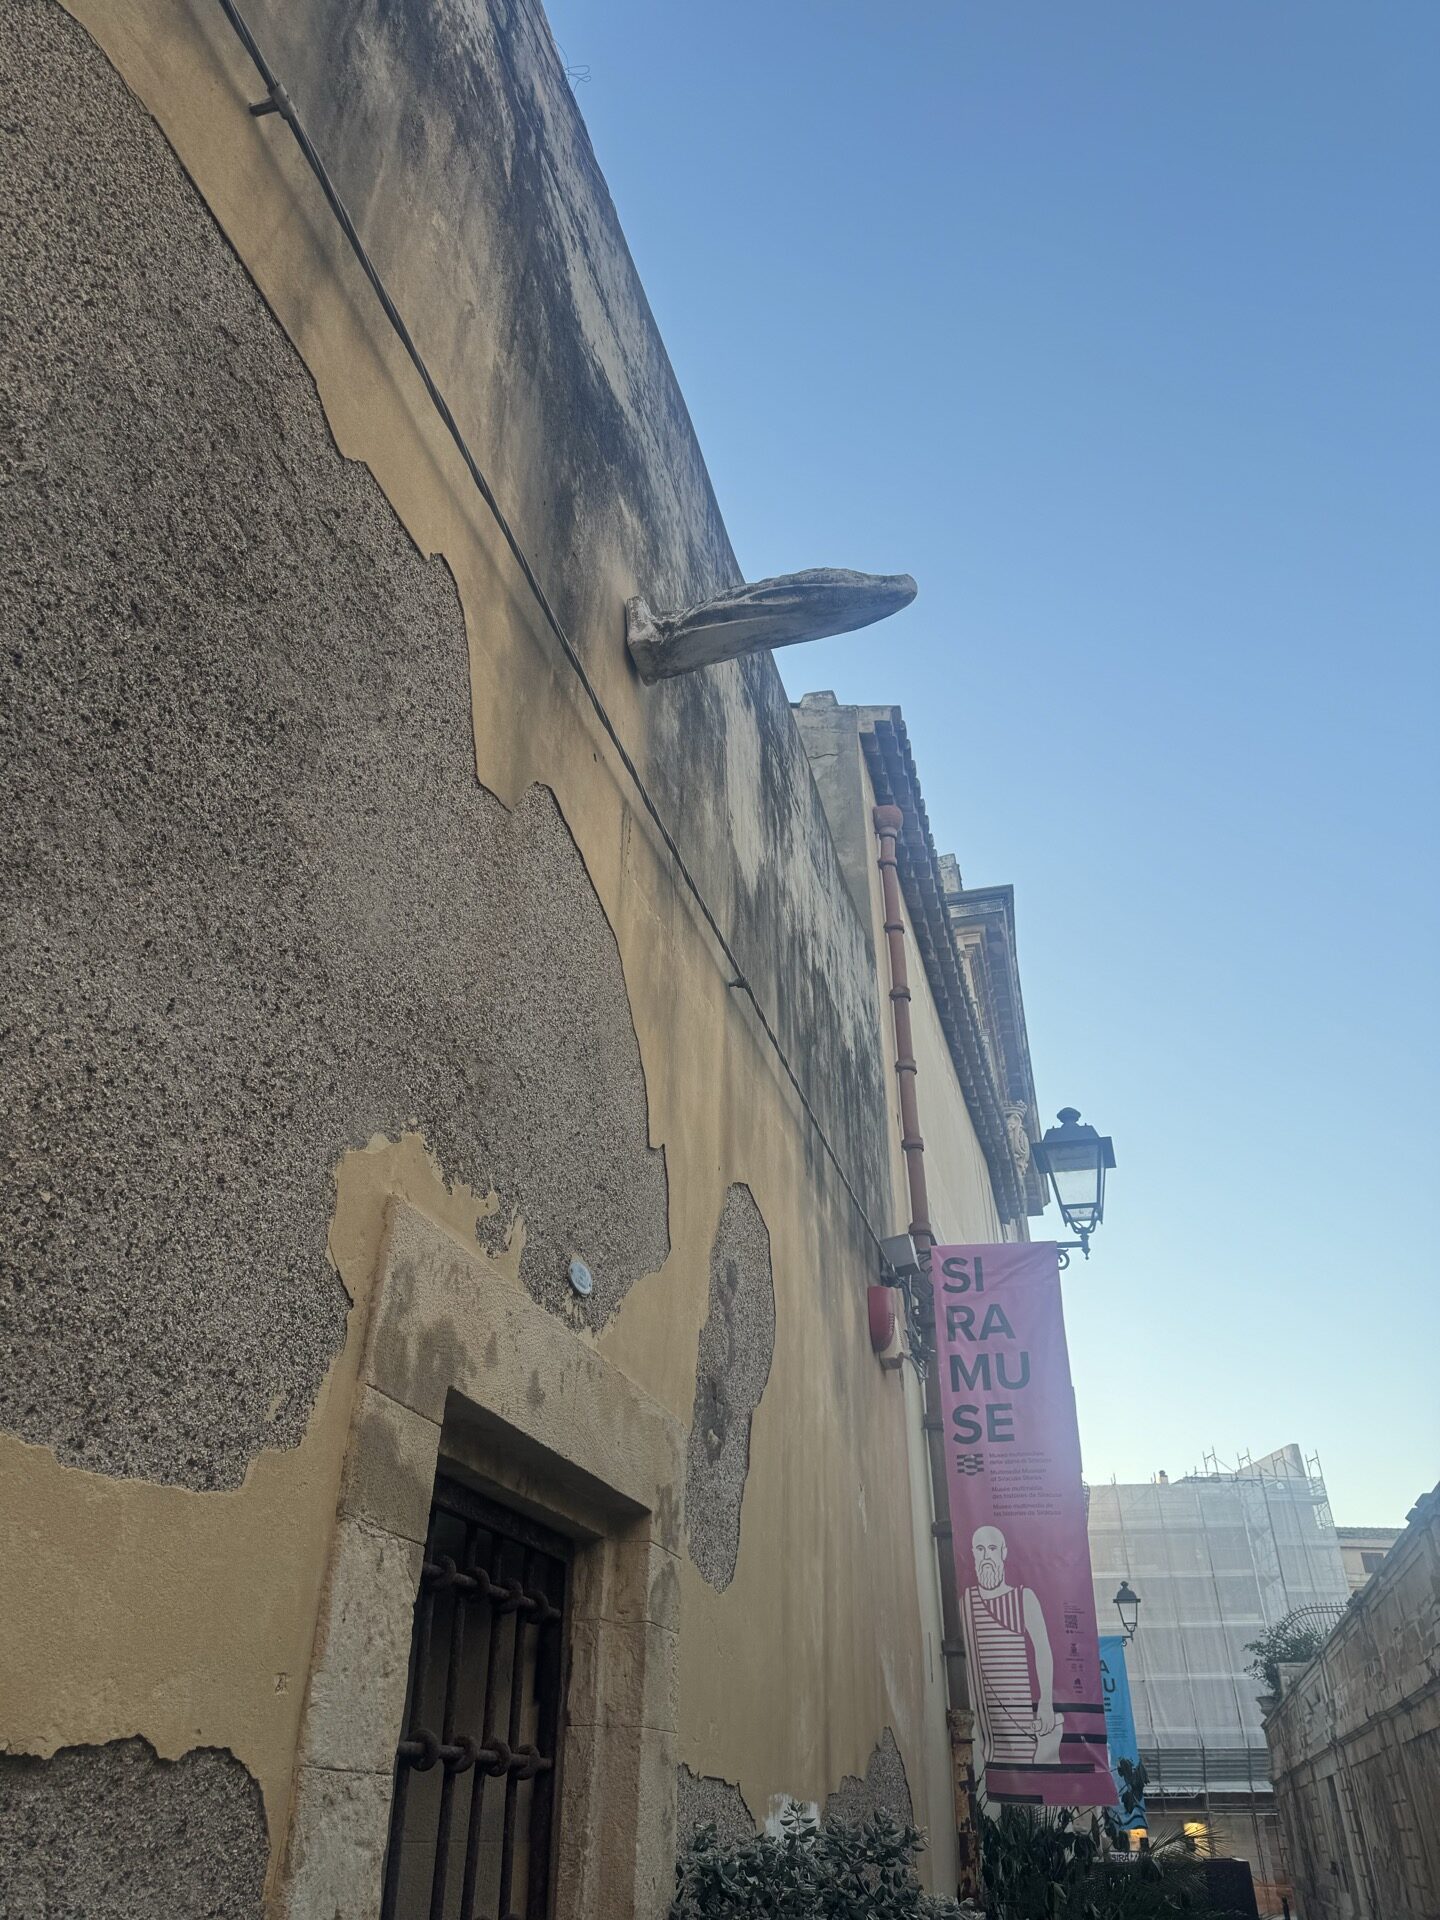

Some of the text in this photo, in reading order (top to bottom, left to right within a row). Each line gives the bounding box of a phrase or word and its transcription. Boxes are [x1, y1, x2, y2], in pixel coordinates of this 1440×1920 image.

[941, 1256, 985, 1294] SI
[946, 1303, 1016, 1342] RA
[949, 1351, 1031, 1393] MU
[952, 1403, 1015, 1445] SE
[1099, 1659, 1110, 1674] A
[1103, 1678, 1116, 1693] U
